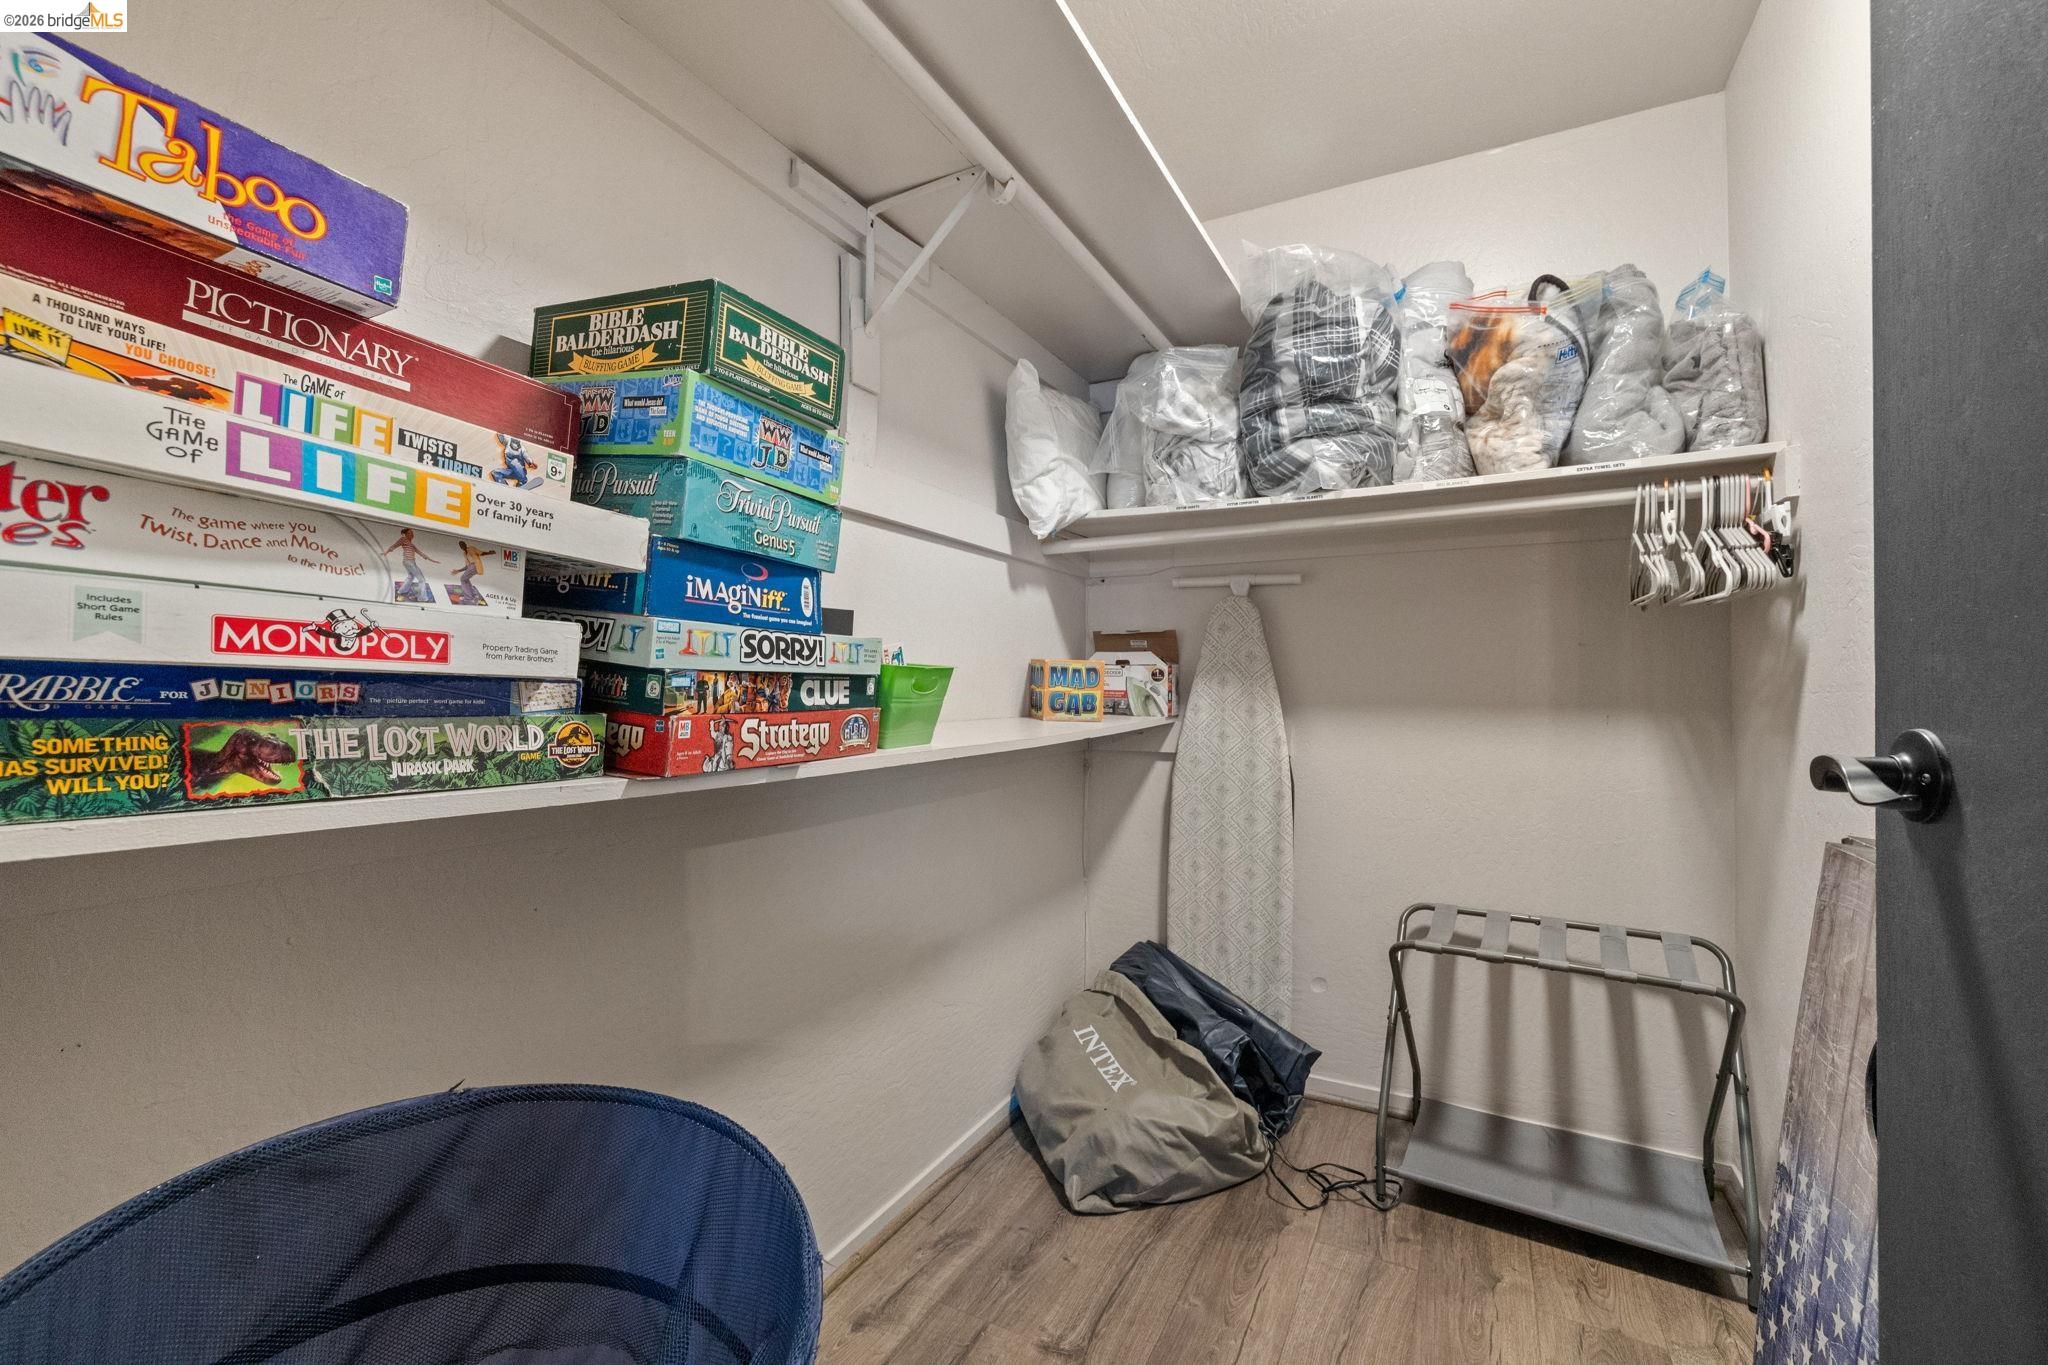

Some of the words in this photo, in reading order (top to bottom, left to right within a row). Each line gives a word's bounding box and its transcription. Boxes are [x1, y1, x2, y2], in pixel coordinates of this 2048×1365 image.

[81, 74, 328, 241] Taboo
[32, 293, 42, 304] A
[46, 297, 111, 325] THOUSAND
[114, 317, 146, 335] WAYS
[184, 276, 414, 378] PICTIONARY
[589, 307, 645, 332] BIBLE
[13, 322, 43, 342] LIVE
[48, 332, 62, 348] IT
[60, 312, 74, 325] TO
[78, 320, 104, 334] LIVE
[106, 327, 138, 343] YOUR
[141, 336, 167, 351] LIFE!
[244, 330, 283, 349] GAME
[555, 320, 679, 353] BALDERDASH
[759, 324, 809, 362] BIBLE
[124, 343, 153, 361] YOU
[158, 353, 217, 379] CHOOSE!
[583, 359, 619, 372] BLUFFING
[617, 353, 641, 370] GAME
[591, 347, 603, 357] the
[604, 344, 635, 356] hilarious
[728, 324, 830, 386] BALDERDASH
[756, 362, 786, 390] BLUFFING
[763, 359, 773, 368] the
[773, 363, 800, 381] hilarious
[282, 373, 298, 386] The
[301, 373, 334, 399] GAME
[334, 389, 346, 400] of
[241, 377, 388, 455] LIFE
[403, 430, 454, 458] TWISTS
[240, 431, 463, 521] LIFE
[422, 453, 434, 467] &
[437, 456, 481, 478] TURNS
[550, 466, 562, 477] 9+
[587, 462, 660, 506] Pursuit
[475, 491, 506, 509] Over
[509, 501, 523, 513] 30
[524, 505, 555, 520] years
[717, 479, 776, 522] Trivial
[766, 492, 824, 536] Pursuit
[171, 506, 195, 523] The
[197, 516, 247, 531] game
[250, 521, 285, 531] where
[288, 521, 317, 534] you
[477, 507, 491, 519] of
[492, 508, 533, 531] family
[533, 517, 552, 532] fun!
[203, 533, 262, 551] Dance
[265, 537, 289, 549] and
[290, 533, 340, 560] Move
[503, 549, 519, 562] MB
[754, 529, 789, 553] Genus
[789, 540, 797, 556] 5
[287, 554, 299, 564] to
[300, 558, 318, 570] the
[319, 562, 367, 577] music!
[76, 602, 106, 614] Short
[109, 605, 141, 615] Game
[86, 592, 132, 604] Includes
[94, 612, 123, 622] Rules
[219, 620, 446, 661] MONOPOLY
[482, 643, 513, 655] Property
[514, 645, 539, 656] Trading
[539, 647, 559, 656] Game
[742, 631, 826, 665] SORRY!
[485, 653, 502, 661] from
[504, 653, 526, 662] Parker
[1049, 665, 1100, 689] MAD
[160, 689, 188, 700] FOR
[197, 679, 359, 702] JUNIORS
[800, 679, 850, 707] CLUE
[1048, 691, 1098, 716] GAB
[680, 721, 690, 731] MB
[737, 716, 831, 761] Stratego
[31, 735, 170, 756] SOMETHING
[287, 726, 362, 762] THE
[366, 722, 440, 761] LOST
[445, 721, 545, 754] WORLD
[551, 747, 564, 755] THE
[563, 746, 577, 755] LOST
[577, 745, 597, 754] WORLD
[44, 754, 170, 775] SURVIVED!
[390, 759, 442, 779] JURASSIC
[443, 757, 476, 775] PARK
[520, 752, 542, 761] GAME
[47, 774, 112, 796] WILL
[114, 772, 170, 791] YOU?
[1072, 1024, 1135, 1093] INTEX
